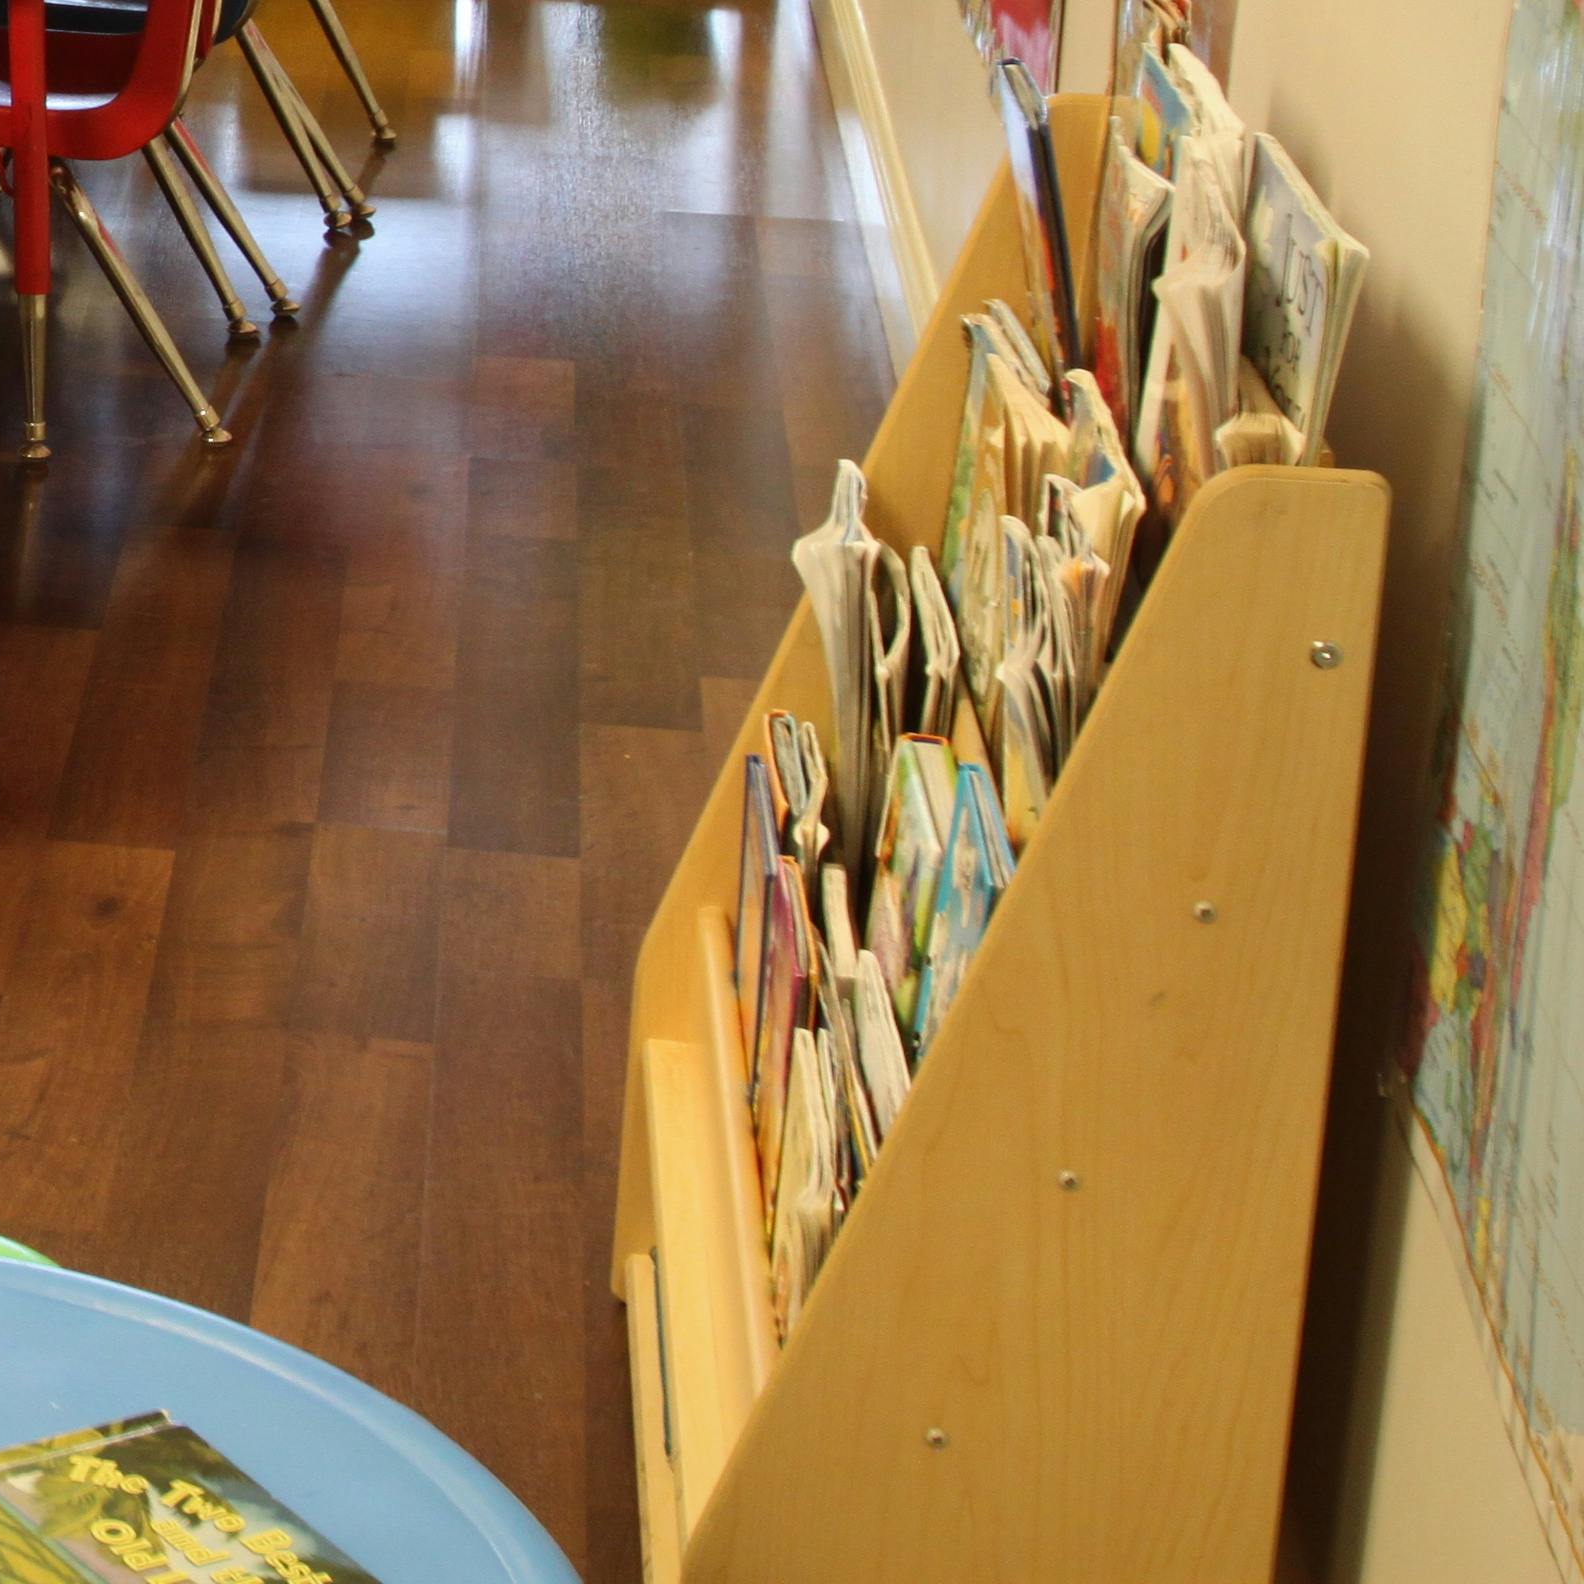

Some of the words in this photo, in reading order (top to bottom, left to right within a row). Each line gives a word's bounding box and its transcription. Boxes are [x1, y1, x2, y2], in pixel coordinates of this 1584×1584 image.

[68, 1455, 150, 1494] The
[160, 1479, 246, 1534] Two
[240, 1528, 334, 1584] Best
[89, 1518, 169, 1572] Old
[151, 1519, 233, 1566] and
